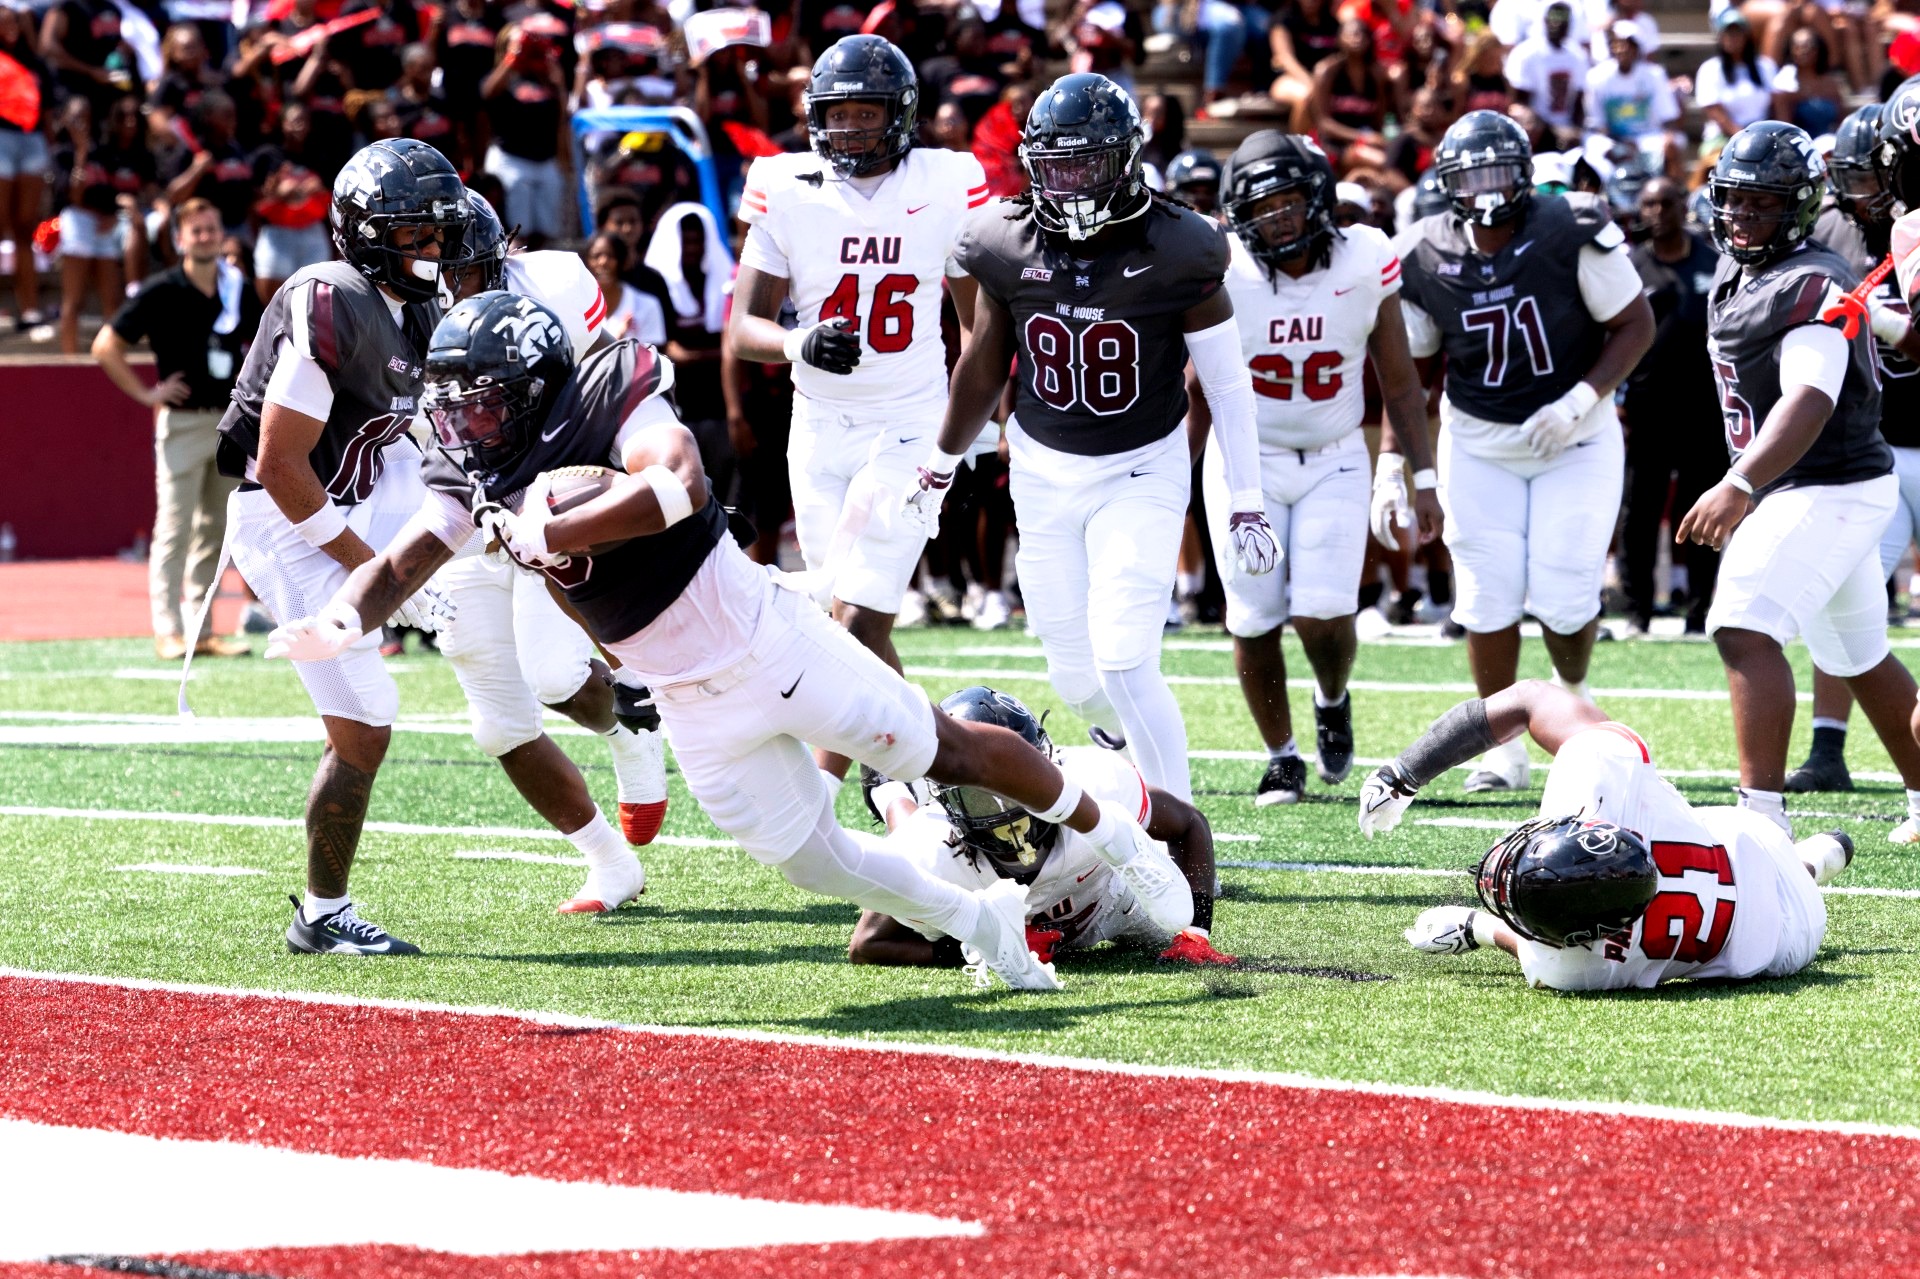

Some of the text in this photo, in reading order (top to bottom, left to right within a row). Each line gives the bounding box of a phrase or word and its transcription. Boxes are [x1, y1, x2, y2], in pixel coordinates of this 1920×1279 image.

[1057, 137, 1088, 147] Riddell
[840, 236, 902, 264] CAU
[1021, 268, 1053, 282] SIAC
[818, 273, 920, 354] 46
[1056, 301, 1105, 321] THE HOUSE
[1268, 316, 1323, 344] CAU
[1461, 295, 1554, 387] 71
[1025, 312, 1140, 416] 88
[1639, 840, 1736, 965] 21
